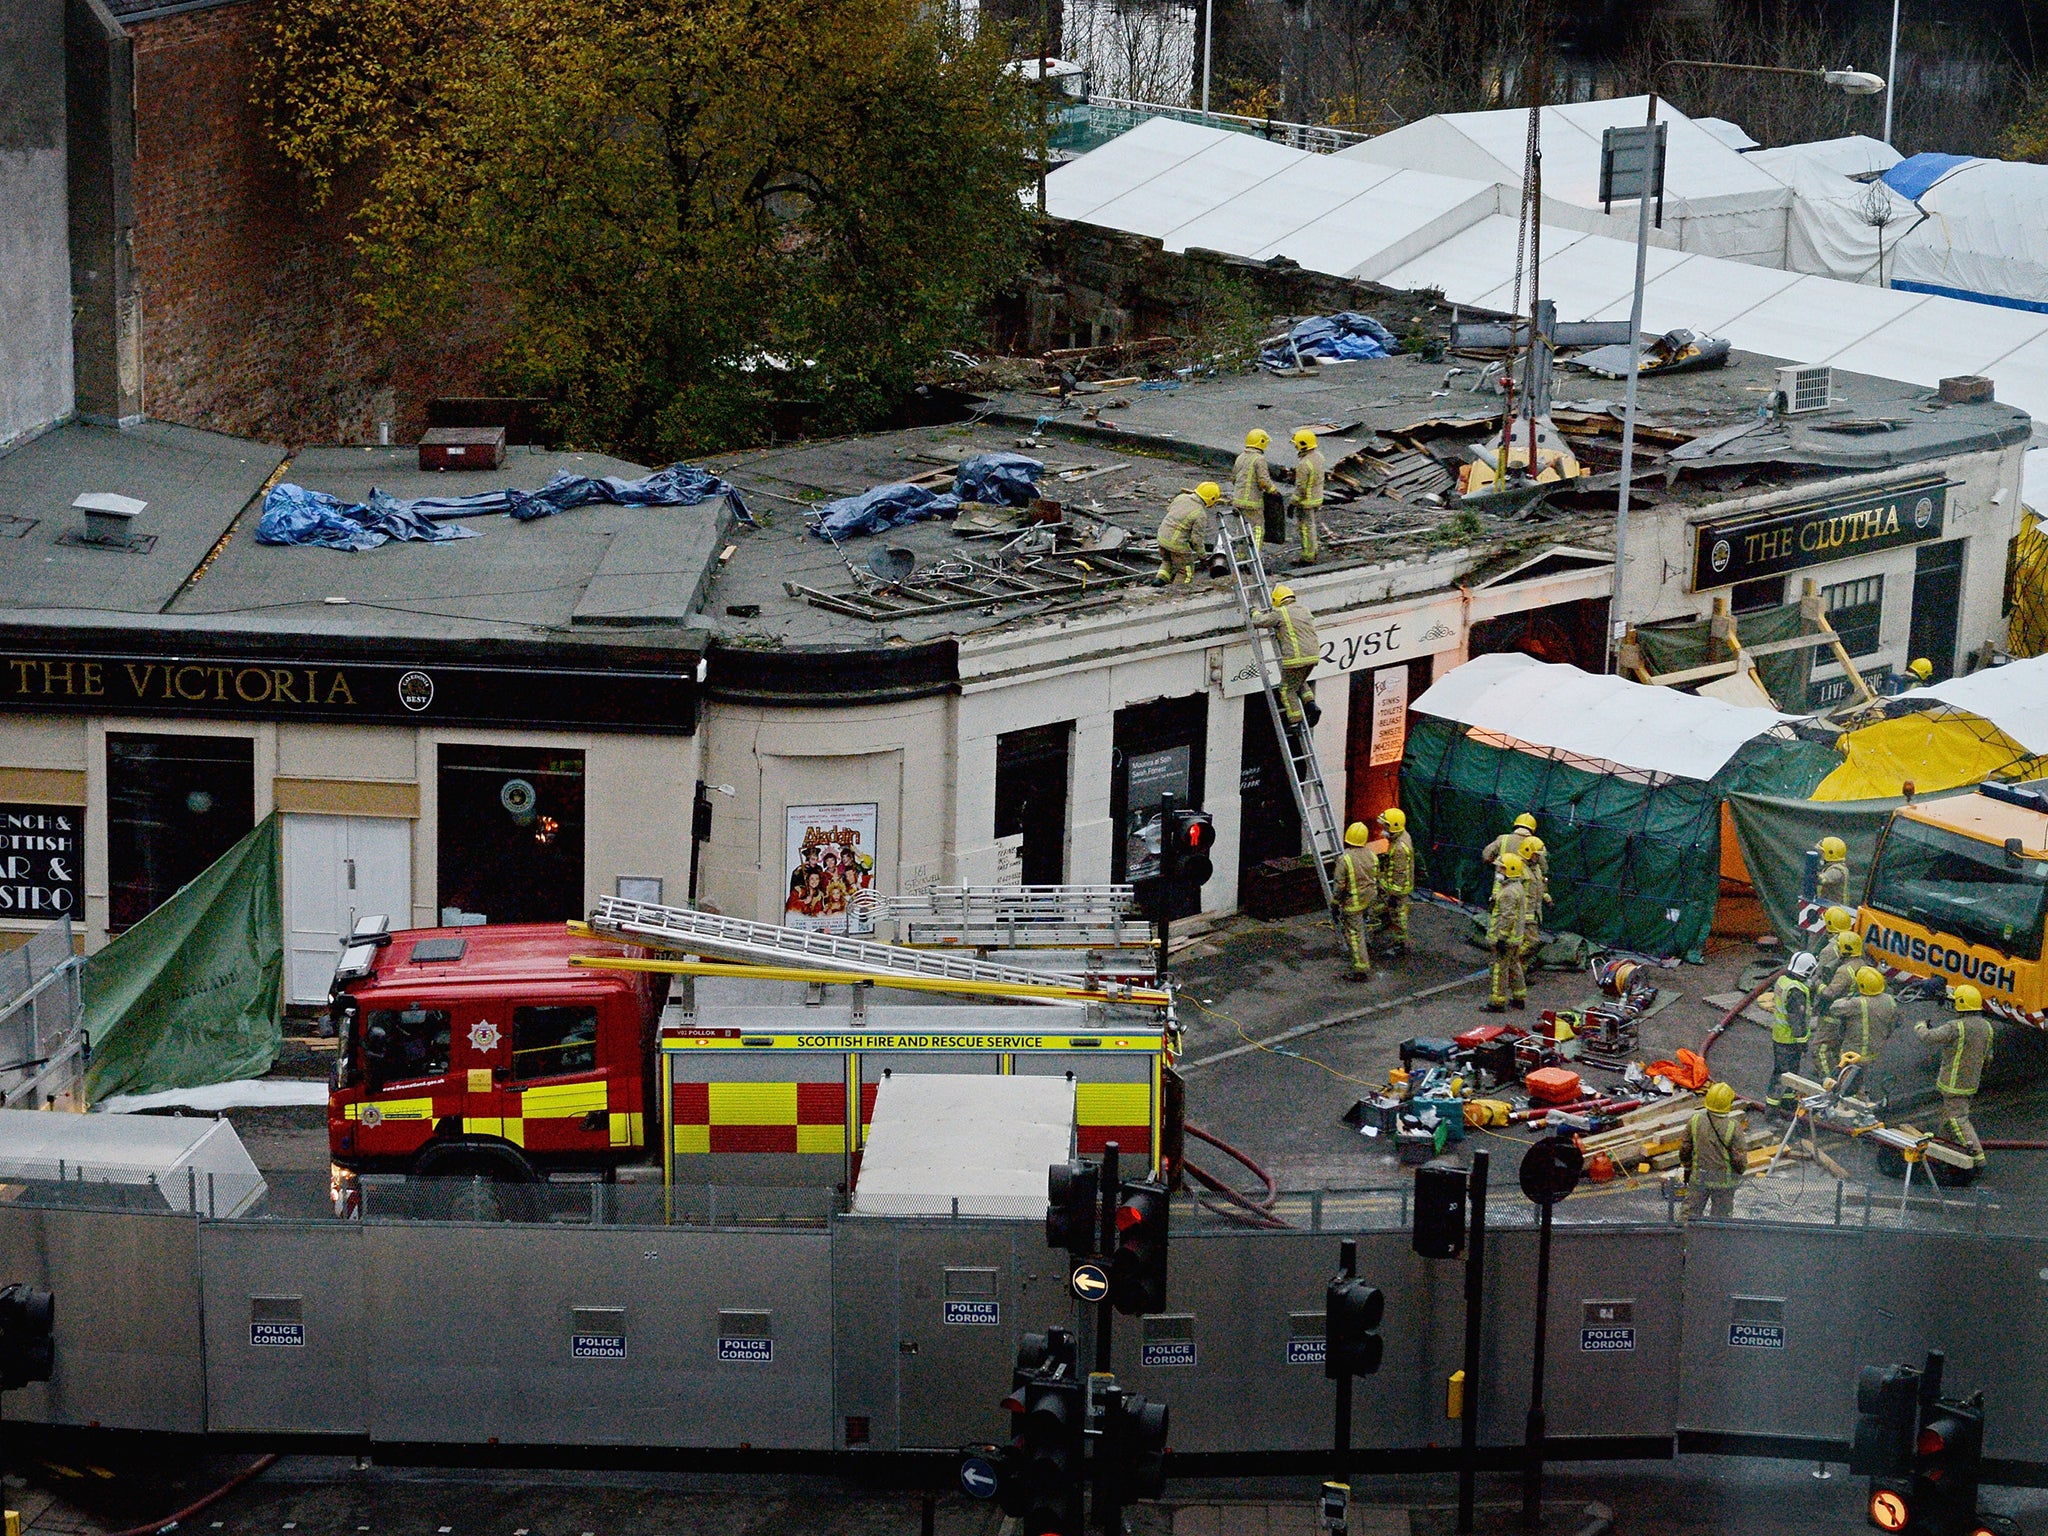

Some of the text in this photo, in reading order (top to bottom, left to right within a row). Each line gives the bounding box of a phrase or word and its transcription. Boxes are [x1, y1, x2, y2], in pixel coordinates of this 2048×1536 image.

[1744, 503, 1902, 565] THE CLUTHA
[9, 658, 358, 705] THE VICTORIA
[406, 695, 428, 704] BEST
[55, 815, 73, 831] &
[47, 857, 73, 882] &
[1864, 923, 2016, 993] AINSCOUGH
[797, 1036, 1042, 1048] SCOTTISH FIRE AND RESCUE SERVICE
[951, 1303, 993, 1313] POLICE
[947, 1313, 996, 1323] CORDON
[256, 1326, 298, 1335] POLICE
[1587, 1330, 1629, 1339] POLICE
[1736, 1326, 1778, 1337] POLICE
[253, 1335, 302, 1344] CORDON
[578, 1338, 620, 1347] POLICE
[1584, 1340, 1632, 1349] CORDON
[1731, 1335, 1781, 1347] CORDON
[724, 1340, 766, 1350] POLICE
[1148, 1345, 1190, 1355] POLICE
[1294, 1343, 1326, 1352] POLIC
[575, 1347, 623, 1357] CORDON
[721, 1350, 770, 1360] CORDON
[1145, 1355, 1193, 1365] CORDON
[1290, 1353, 1326, 1362] CORD
